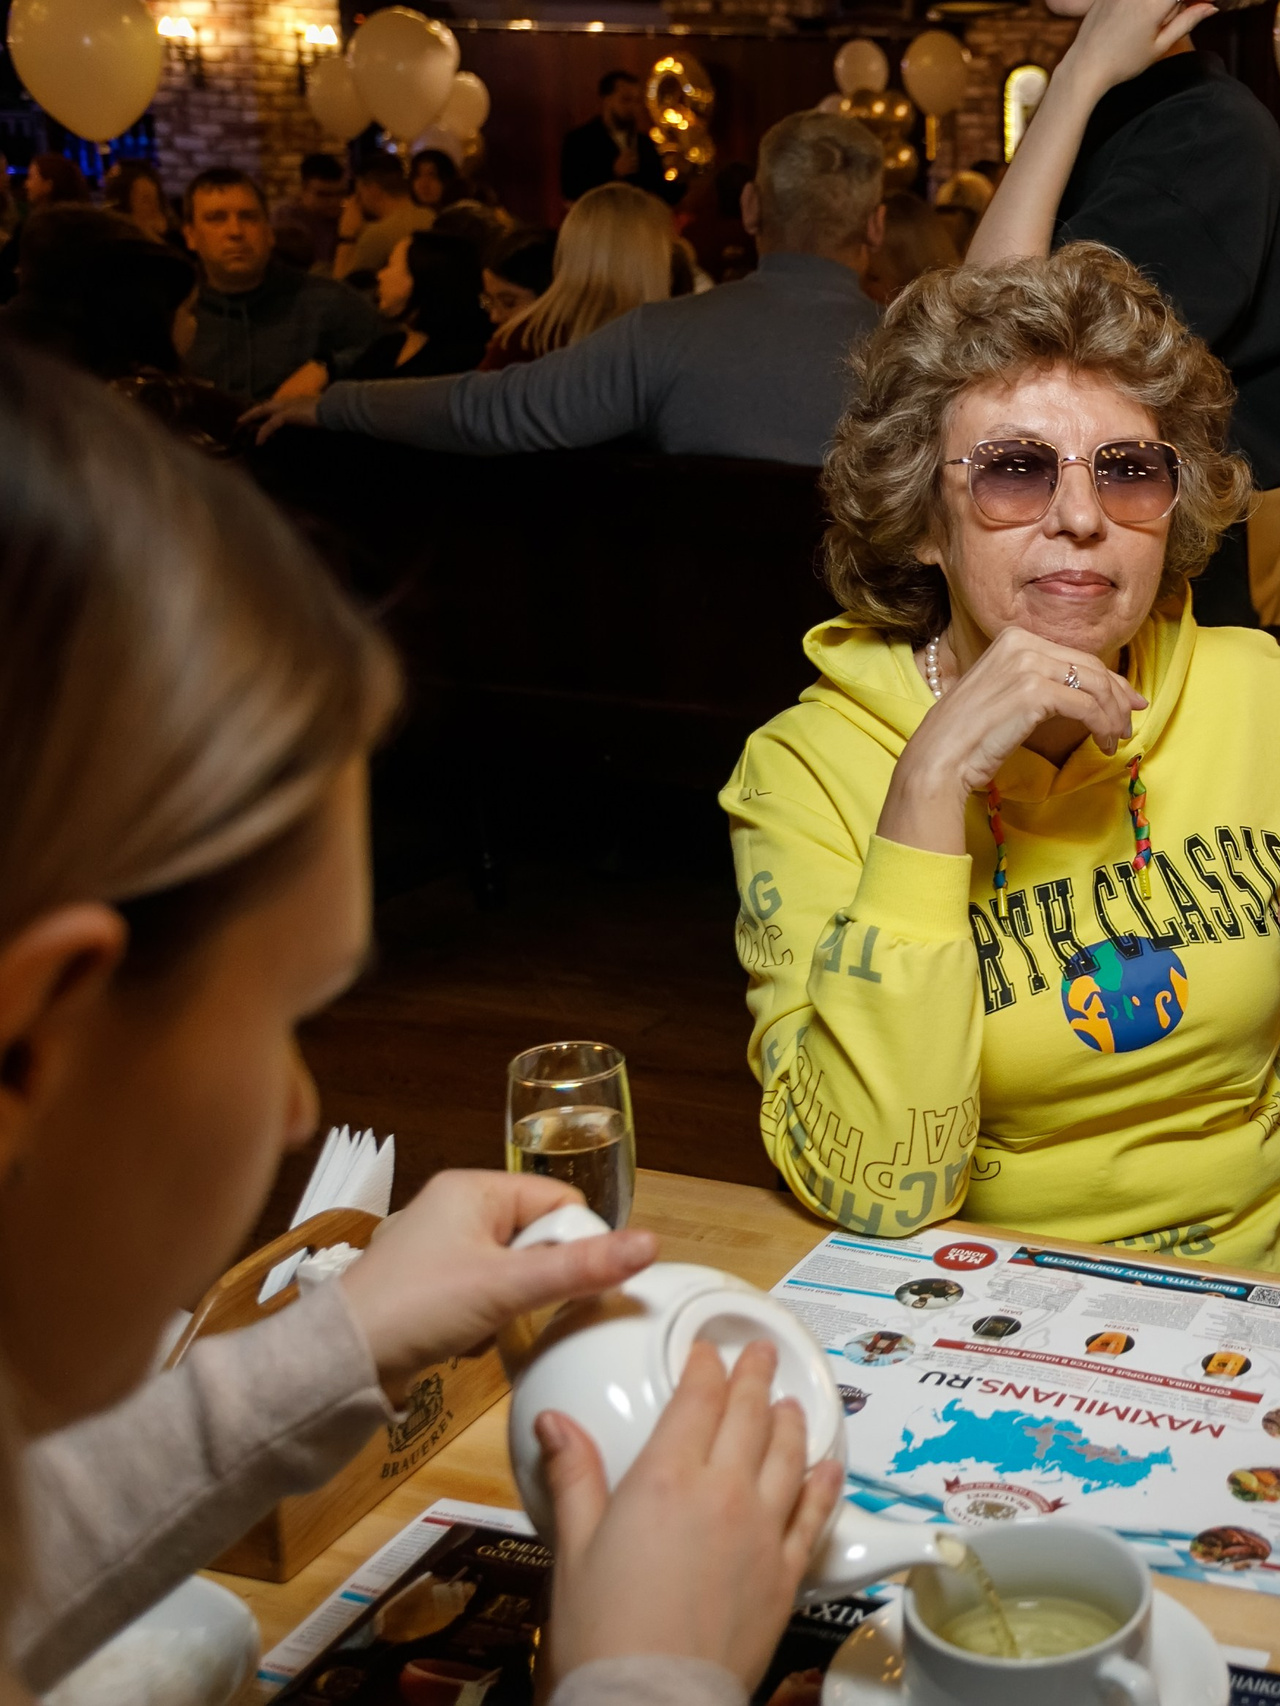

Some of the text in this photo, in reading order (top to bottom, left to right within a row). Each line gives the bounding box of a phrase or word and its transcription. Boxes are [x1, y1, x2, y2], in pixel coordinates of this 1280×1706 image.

[944, 1252, 981, 1265] MAX
[948, 1247, 988, 1259] BONUS
[1043, 1255, 1238, 1294] ВЫПУСТИТЬ КАРТУ ЛОЯЛЬНОСТИ
[963, 1343, 1232, 1396] СОРТА ПИВА, КОТОРЫЕ ВАРЯТСЯ В НАШЕМ РЕСТОРАНЕ
[918, 1371, 1226, 1438] MAXIMILIANS.RU
[380, 1410, 454, 1478] BRAUEREI
